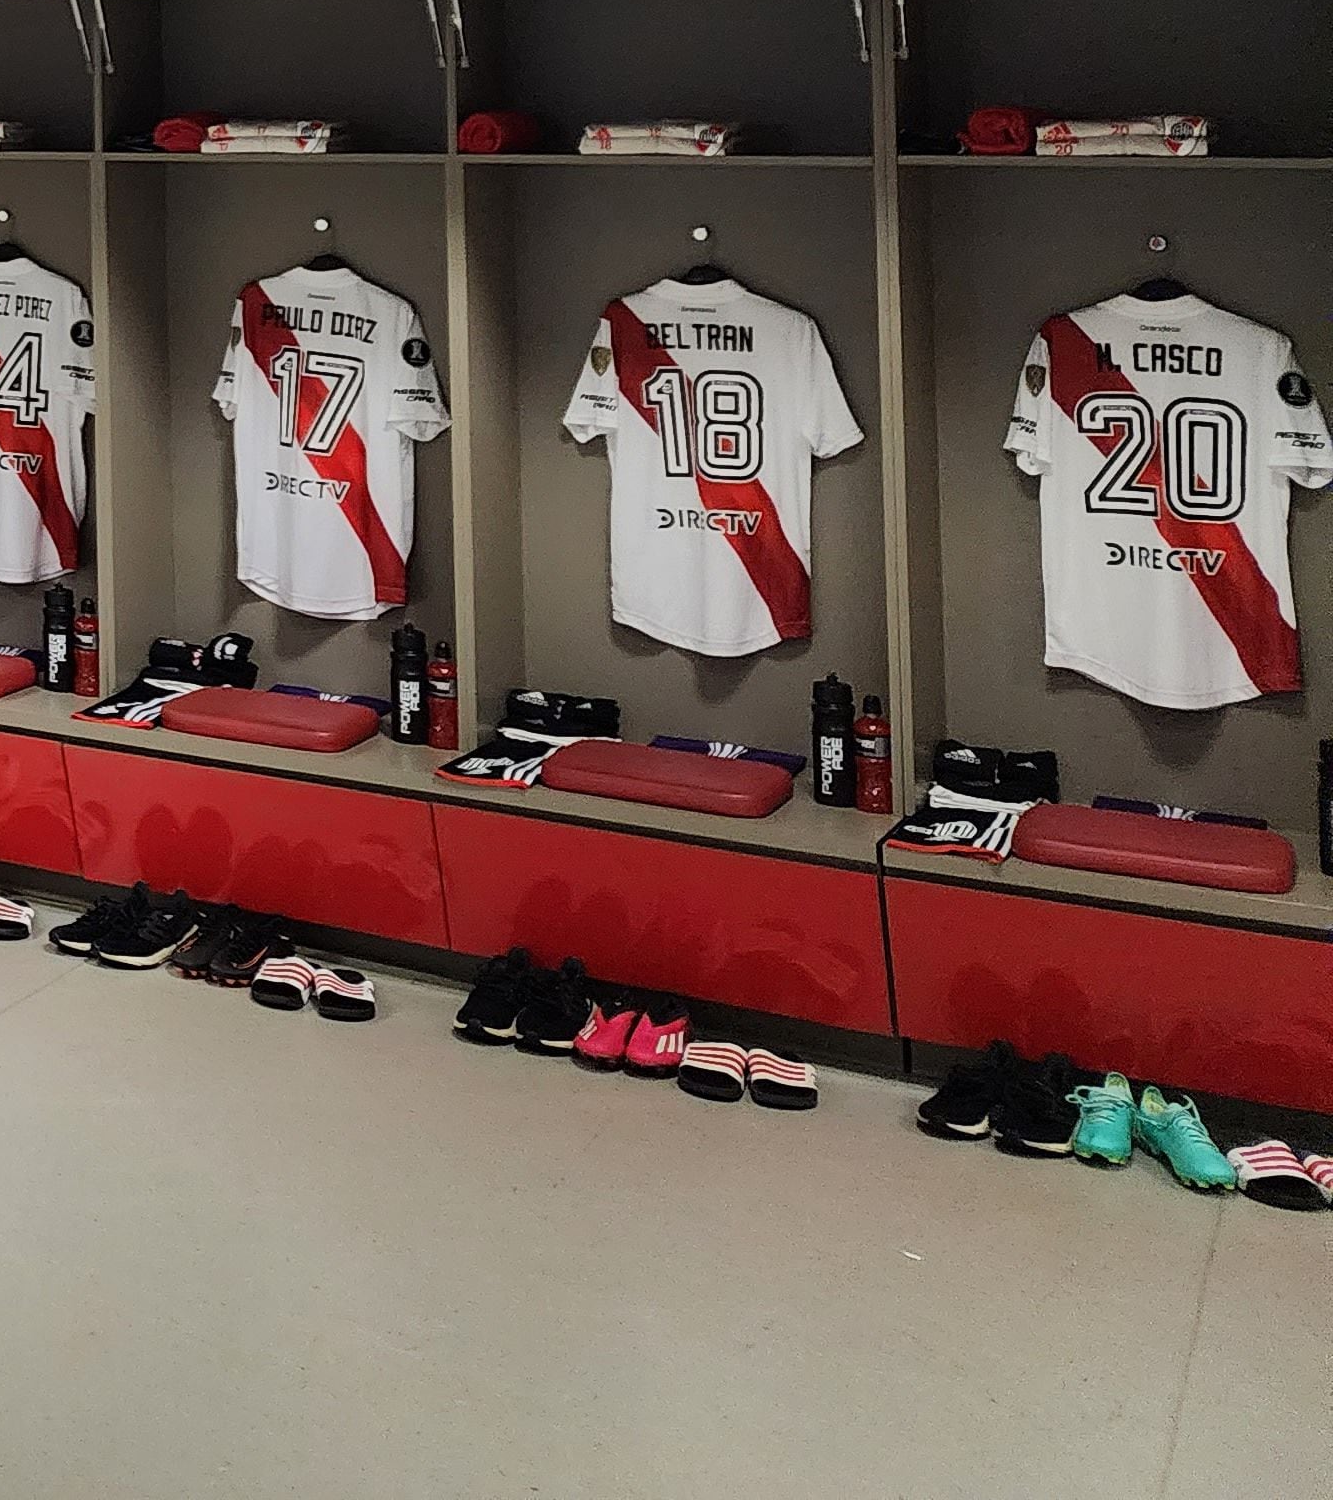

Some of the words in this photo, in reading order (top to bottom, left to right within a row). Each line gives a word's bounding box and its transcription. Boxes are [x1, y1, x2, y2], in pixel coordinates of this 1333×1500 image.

[1110, 123, 1130, 136] 20
[1055, 144, 1073, 156] 20
[14, 296, 53, 322] PIREZ
[261, 303, 323, 334] PAULO
[330, 310, 379, 344] DIAZ
[645, 323, 754, 354] BELTRAN
[1133, 342, 1223, 378] CASCO
[270, 345, 365, 455] 17
[642, 366, 764, 484] 18
[1076, 393, 1248, 523] 20
[656, 507, 763, 537] DIRECTV
[1103, 541, 1225, 577] DIRECTV
[48, 633, 60, 683] POWER
[399, 680, 411, 735] POWER
[820, 735, 833, 796] POWER
[832, 735, 844, 771] ADE
